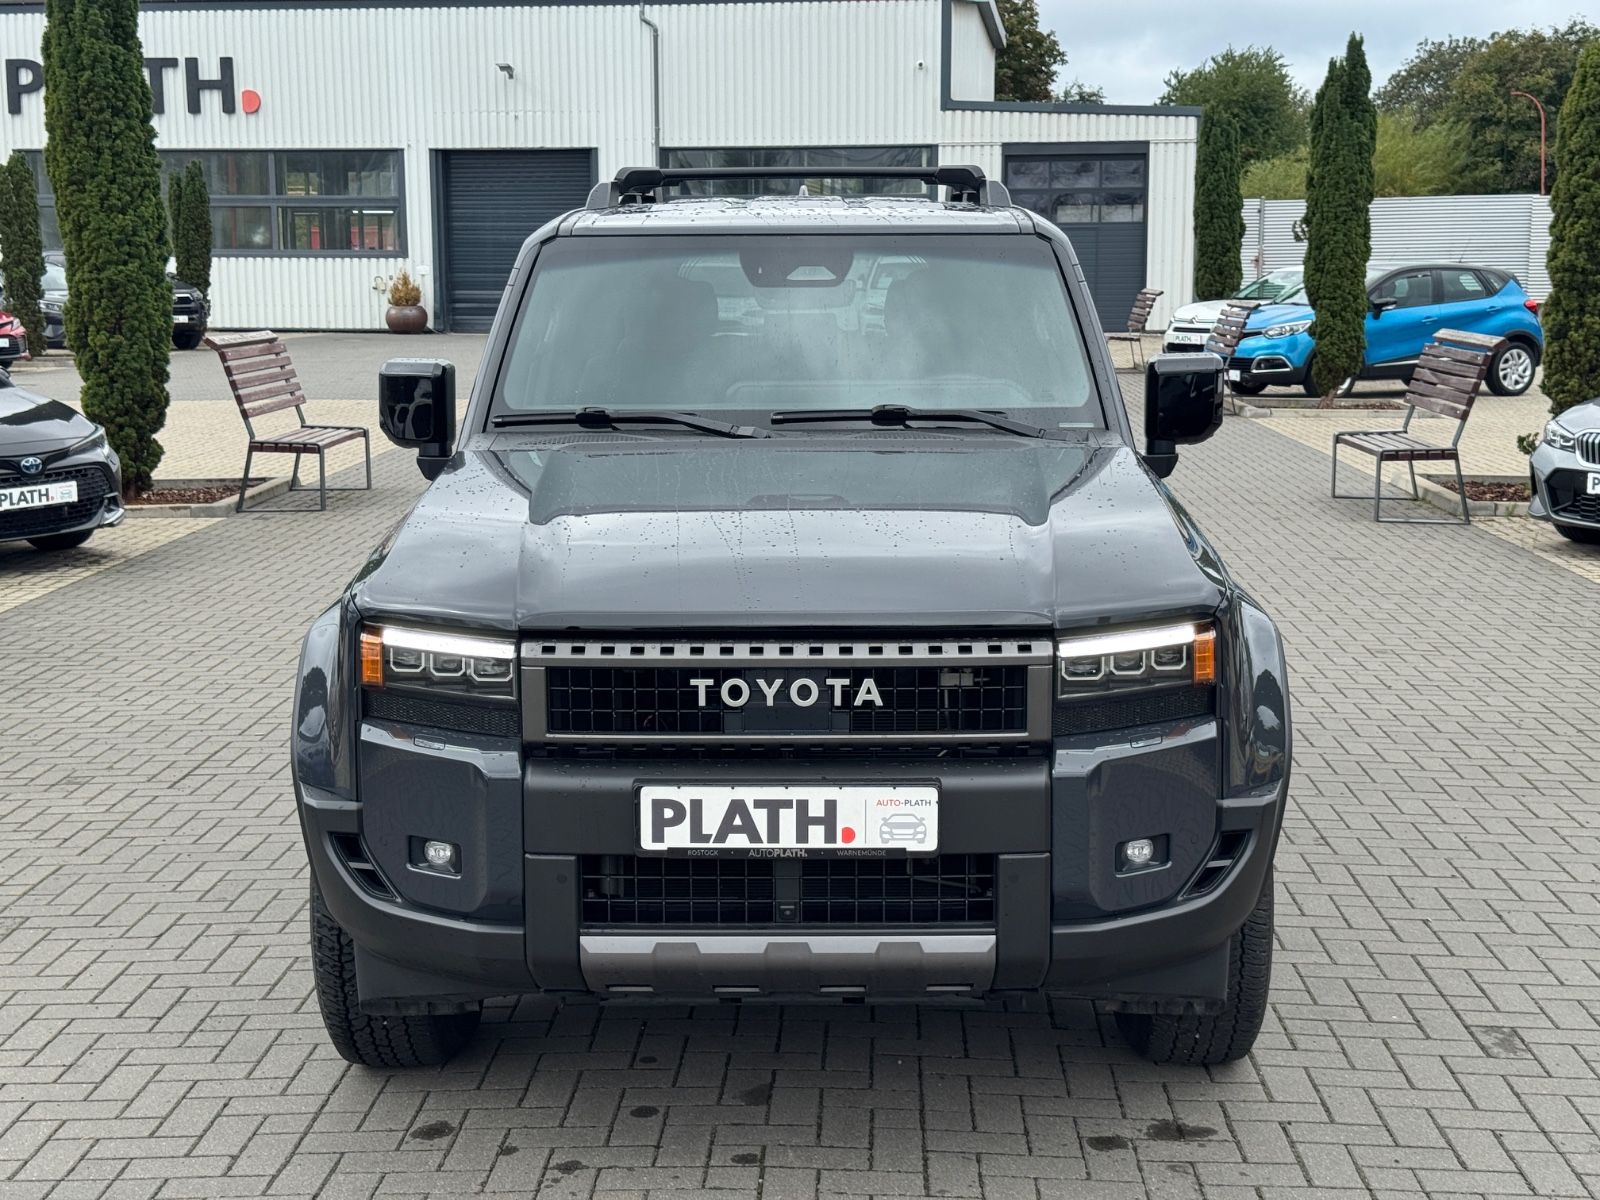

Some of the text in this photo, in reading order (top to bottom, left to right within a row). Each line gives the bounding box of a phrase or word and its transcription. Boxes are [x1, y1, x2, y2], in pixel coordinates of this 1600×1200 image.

[5, 57, 262, 115] PTH.
[689, 677, 884, 707] TOYOTA
[876, 799, 932, 808] AUTO-PLATH
[651, 798, 856, 844] PLATH.
[687, 849, 719, 857] ROSTOCK
[836, 848, 886, 856] WARNEMÜNDE
